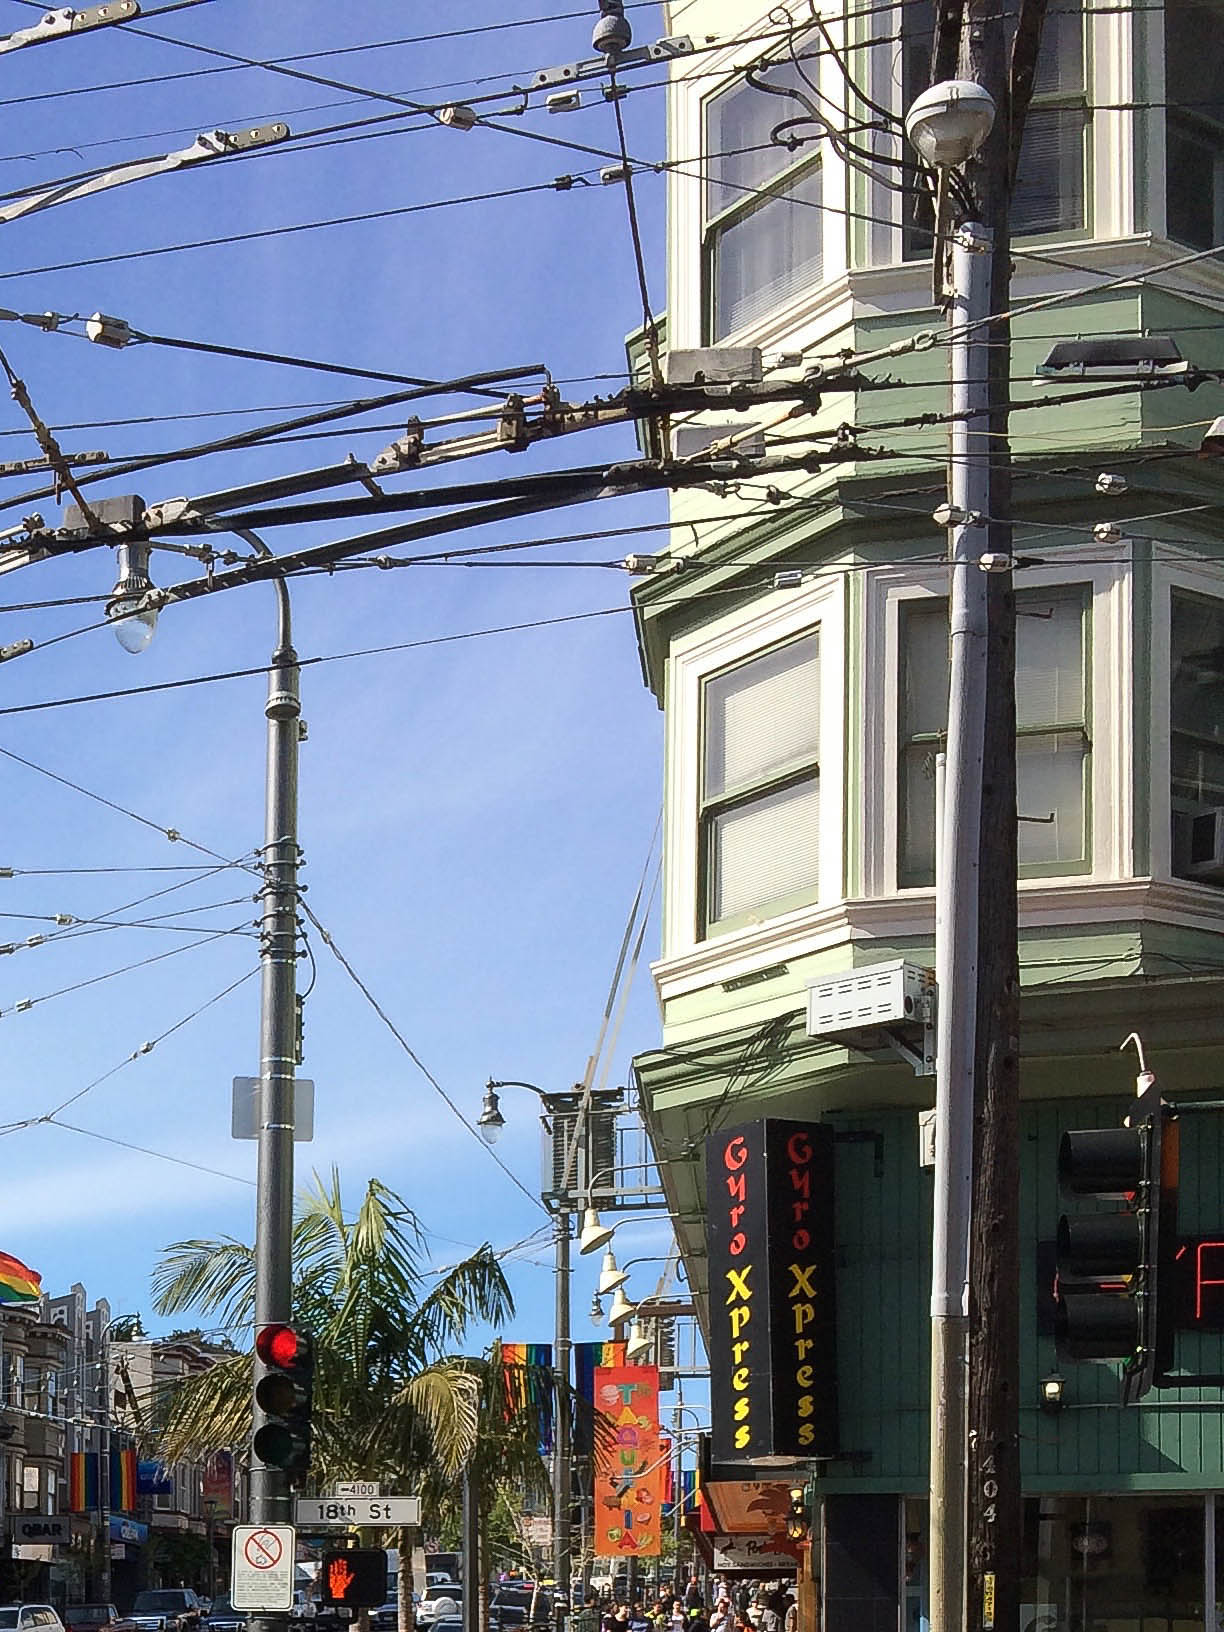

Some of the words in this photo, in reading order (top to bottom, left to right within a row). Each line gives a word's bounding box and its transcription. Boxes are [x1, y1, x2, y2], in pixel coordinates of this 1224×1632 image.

[725, 1136, 748, 1256] Gyro
[787, 1131, 813, 1251] Gyro
[725, 1264, 753, 1449] Xpress
[787, 1263, 817, 1446] Xpress
[22, 1523, 63, 1538] QBAR
[317, 1503, 356, 1520] 18th
[368, 1503, 392, 1520] St
